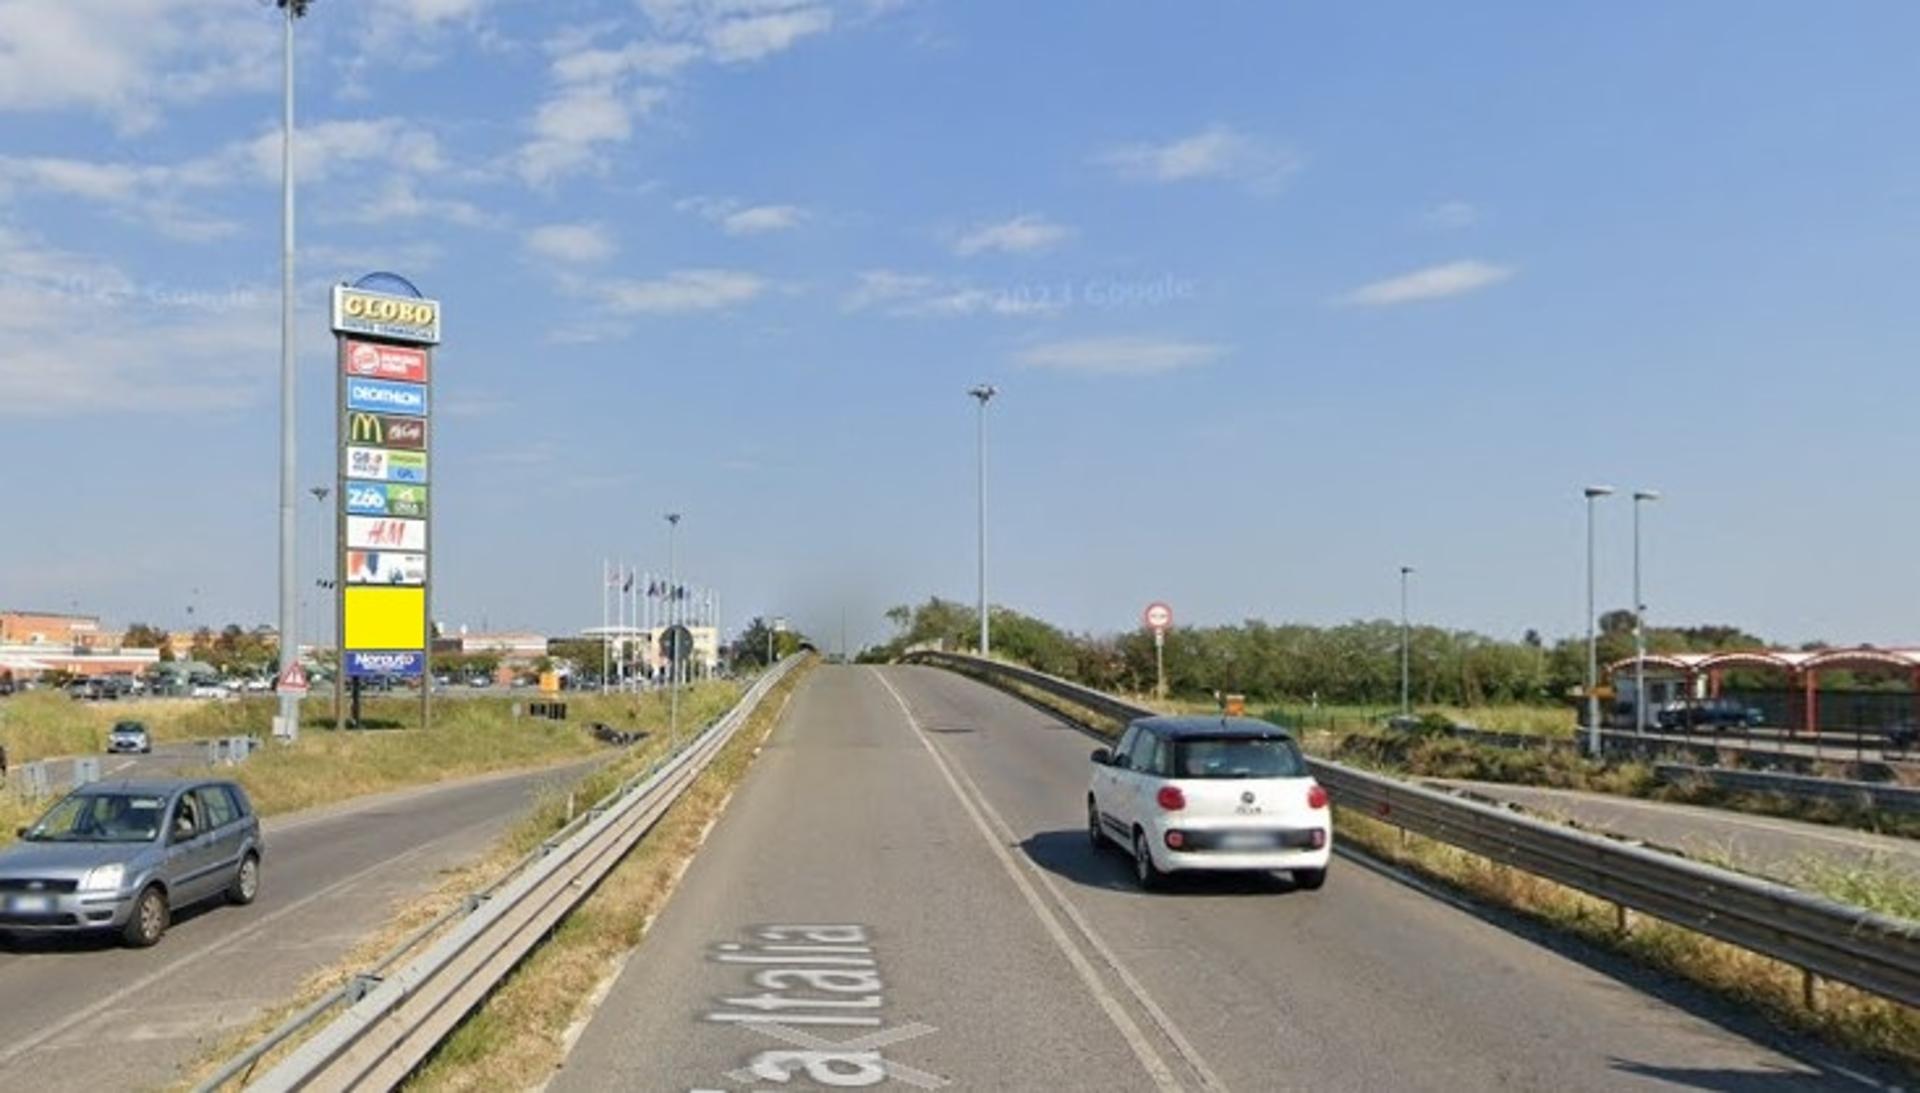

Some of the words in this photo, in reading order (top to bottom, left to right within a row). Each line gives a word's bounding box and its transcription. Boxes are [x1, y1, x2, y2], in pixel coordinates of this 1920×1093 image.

[344, 295, 434, 327] GLOBO
[353, 386, 421, 405] DECATHLON
[354, 653, 414, 666] Norauto
